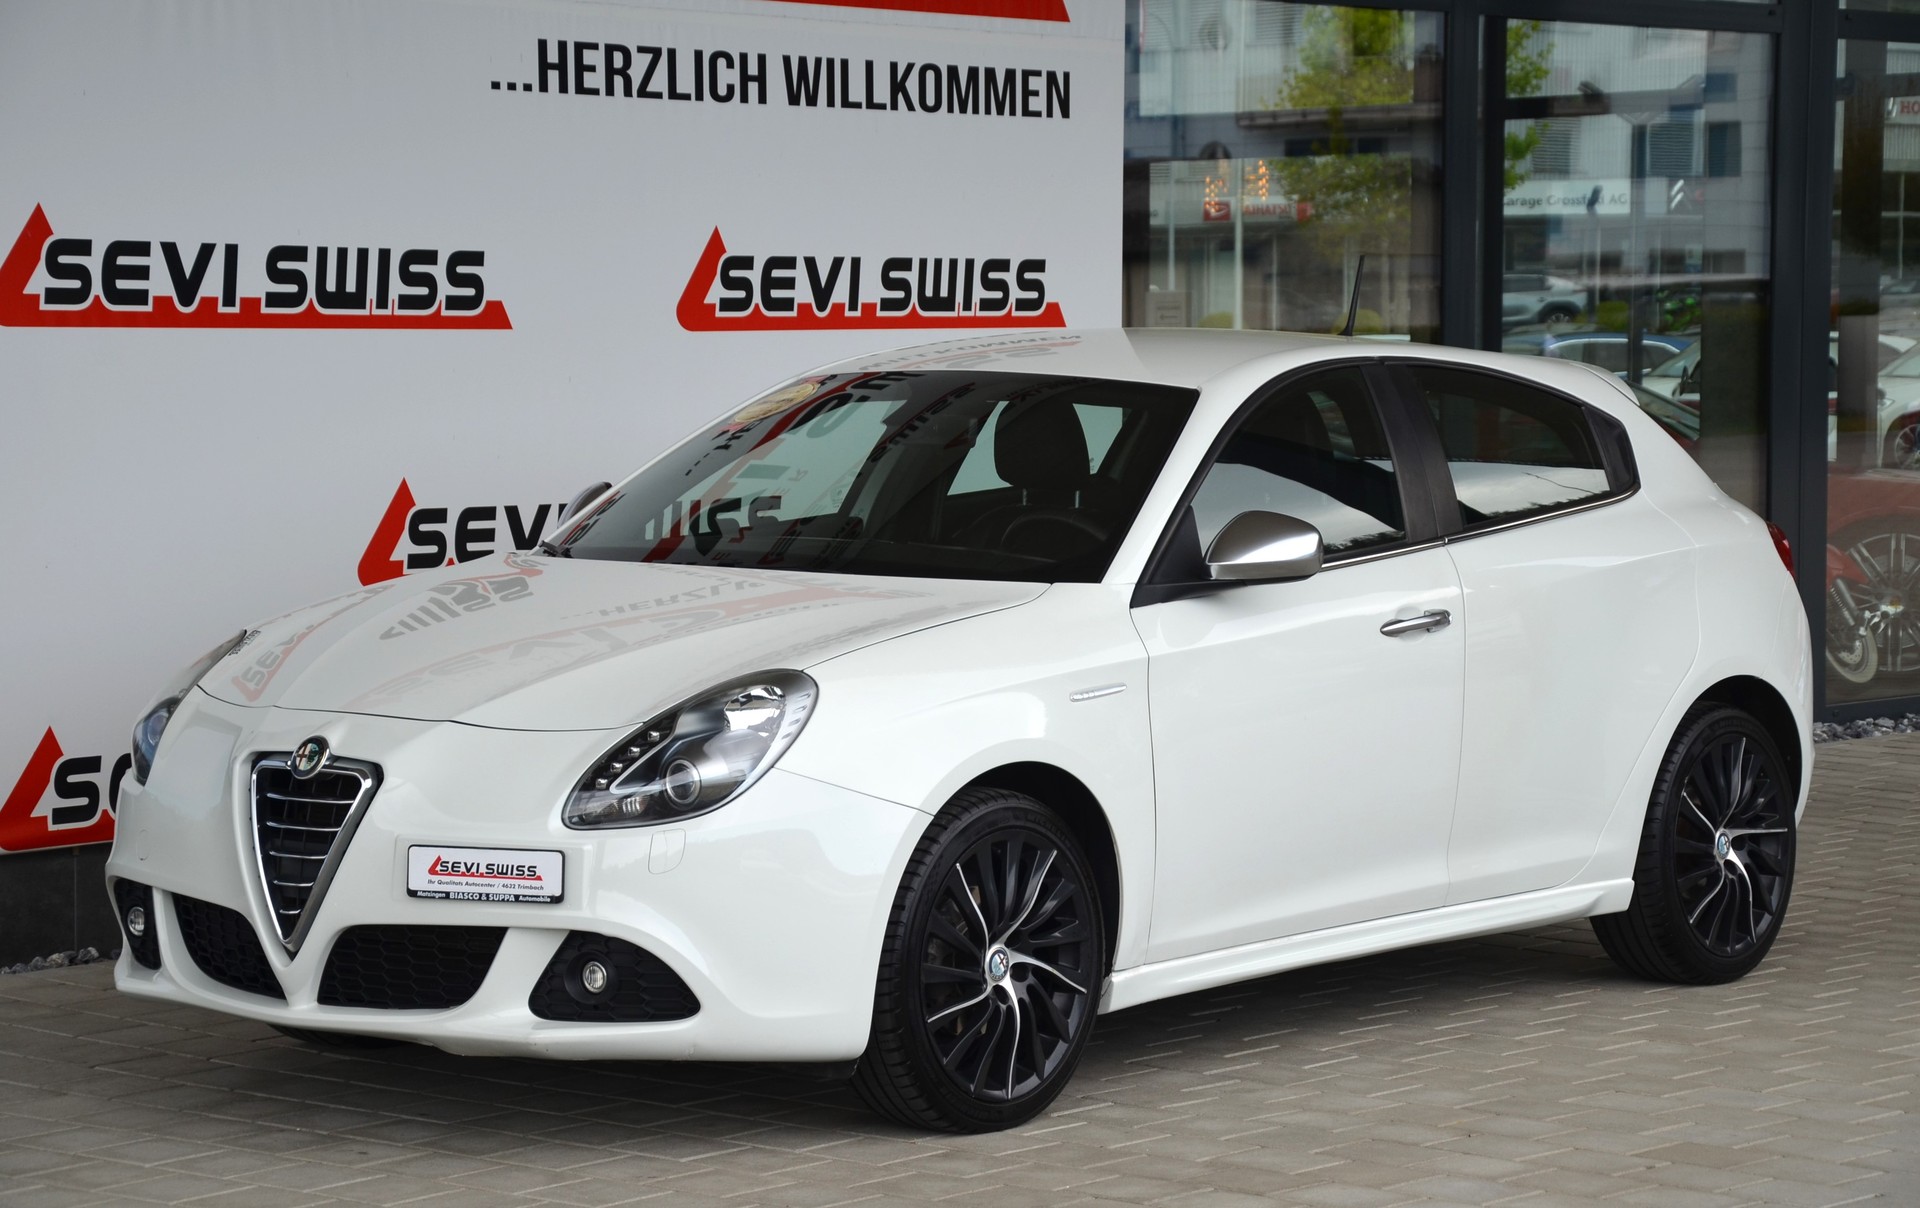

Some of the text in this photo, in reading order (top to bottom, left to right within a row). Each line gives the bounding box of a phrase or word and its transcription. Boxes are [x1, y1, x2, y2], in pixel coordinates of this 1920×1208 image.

[782, 54, 1070, 119] WILLKOMMEN
[1503, 196, 1543, 208] arage
[44, 238, 485, 311] SEVI SWISS
[718, 255, 1046, 313] SEVI SWISS
[407, 503, 569, 570] SEV
[439, 860, 537, 877] SEVI SWISS
[464, 880, 496, 888] Autocenter
[517, 883, 544, 891] Trimbach
[449, 891, 480, 901] BIASCO
[481, 892, 488, 901] &
[488, 893, 516, 902] SUPPA
